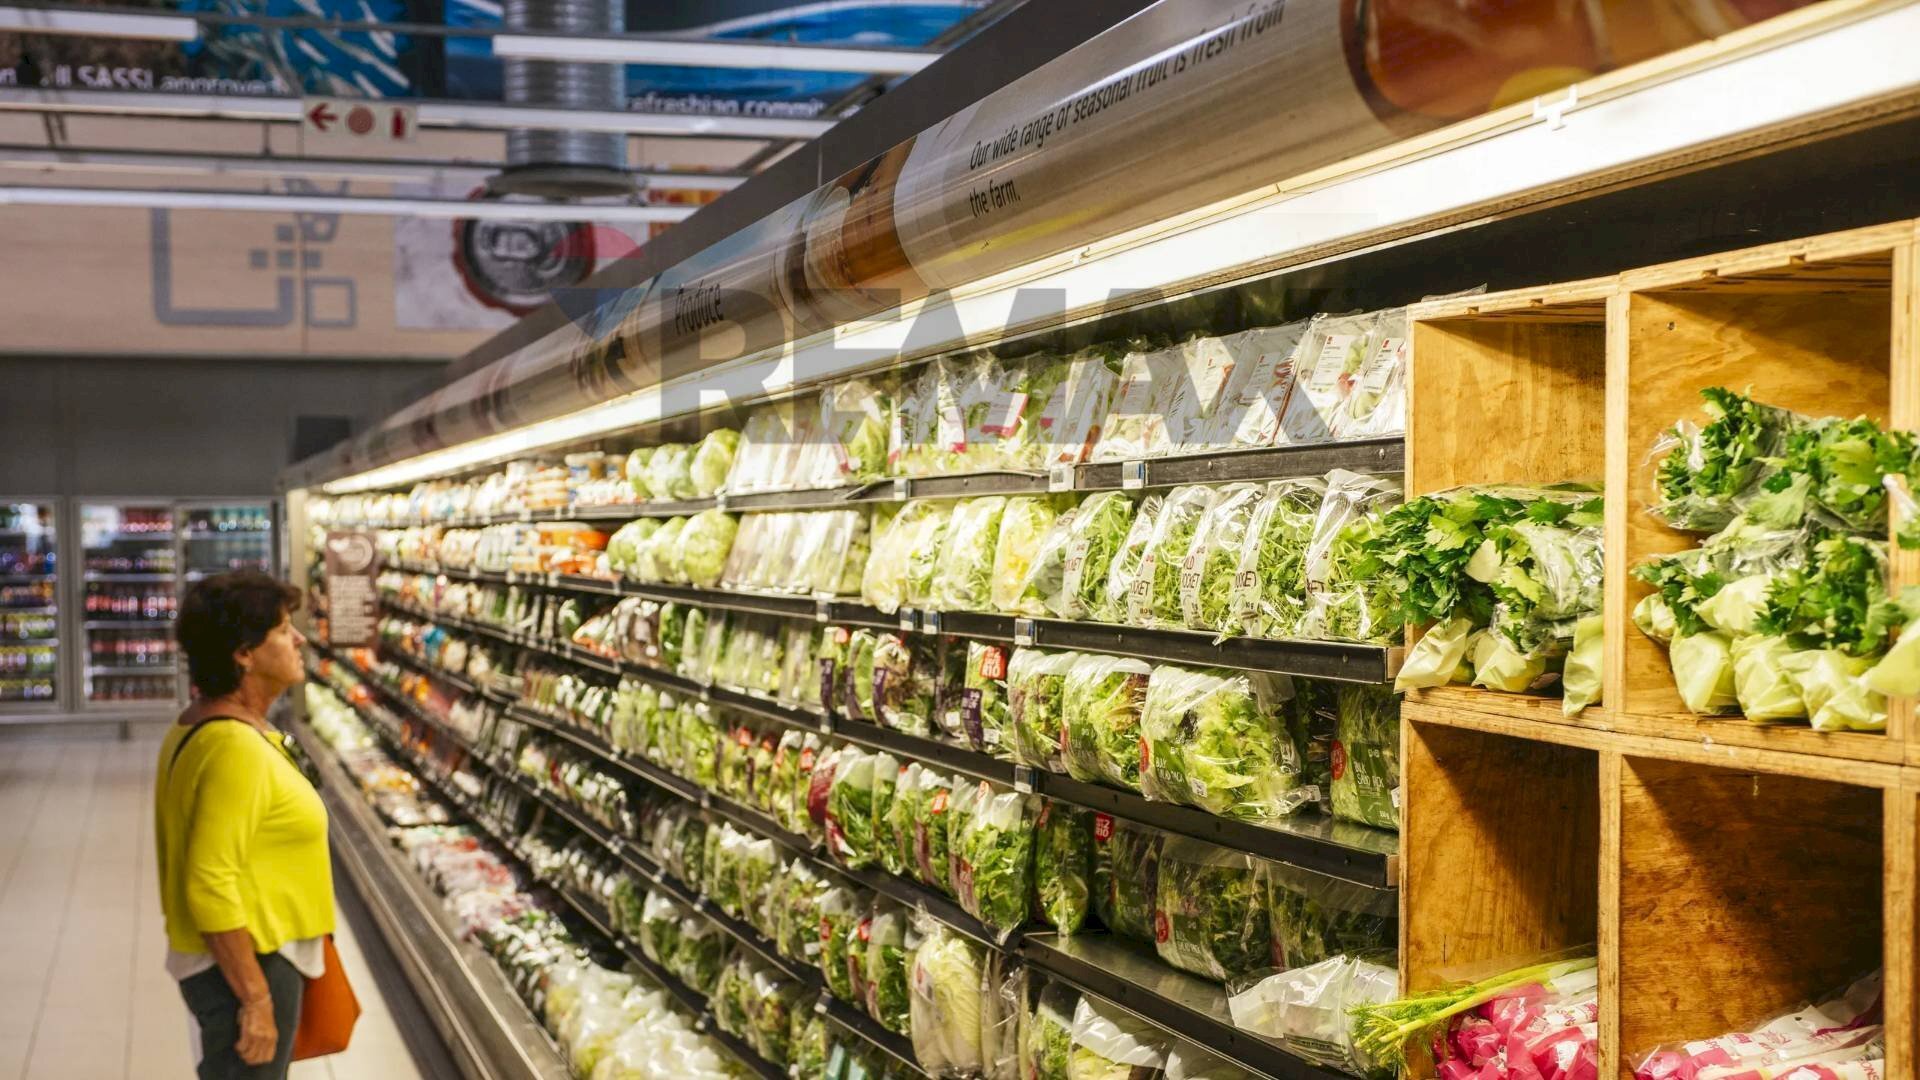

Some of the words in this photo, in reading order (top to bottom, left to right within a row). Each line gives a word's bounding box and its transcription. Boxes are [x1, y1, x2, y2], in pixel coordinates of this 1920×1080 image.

[969, 140, 991, 171] Our
[992, 125, 1019, 160] wide
[1019, 110, 1055, 149] range
[1072, 76, 1134, 124] seasonal
[1135, 60, 1169, 93] fruit
[1192, 14, 1238, 66] fresh
[1241, 1, 1286, 42] from
[969, 186, 989, 218] the
[989, 178, 1021, 210] farm.
[675, 280, 725, 336] Produce
